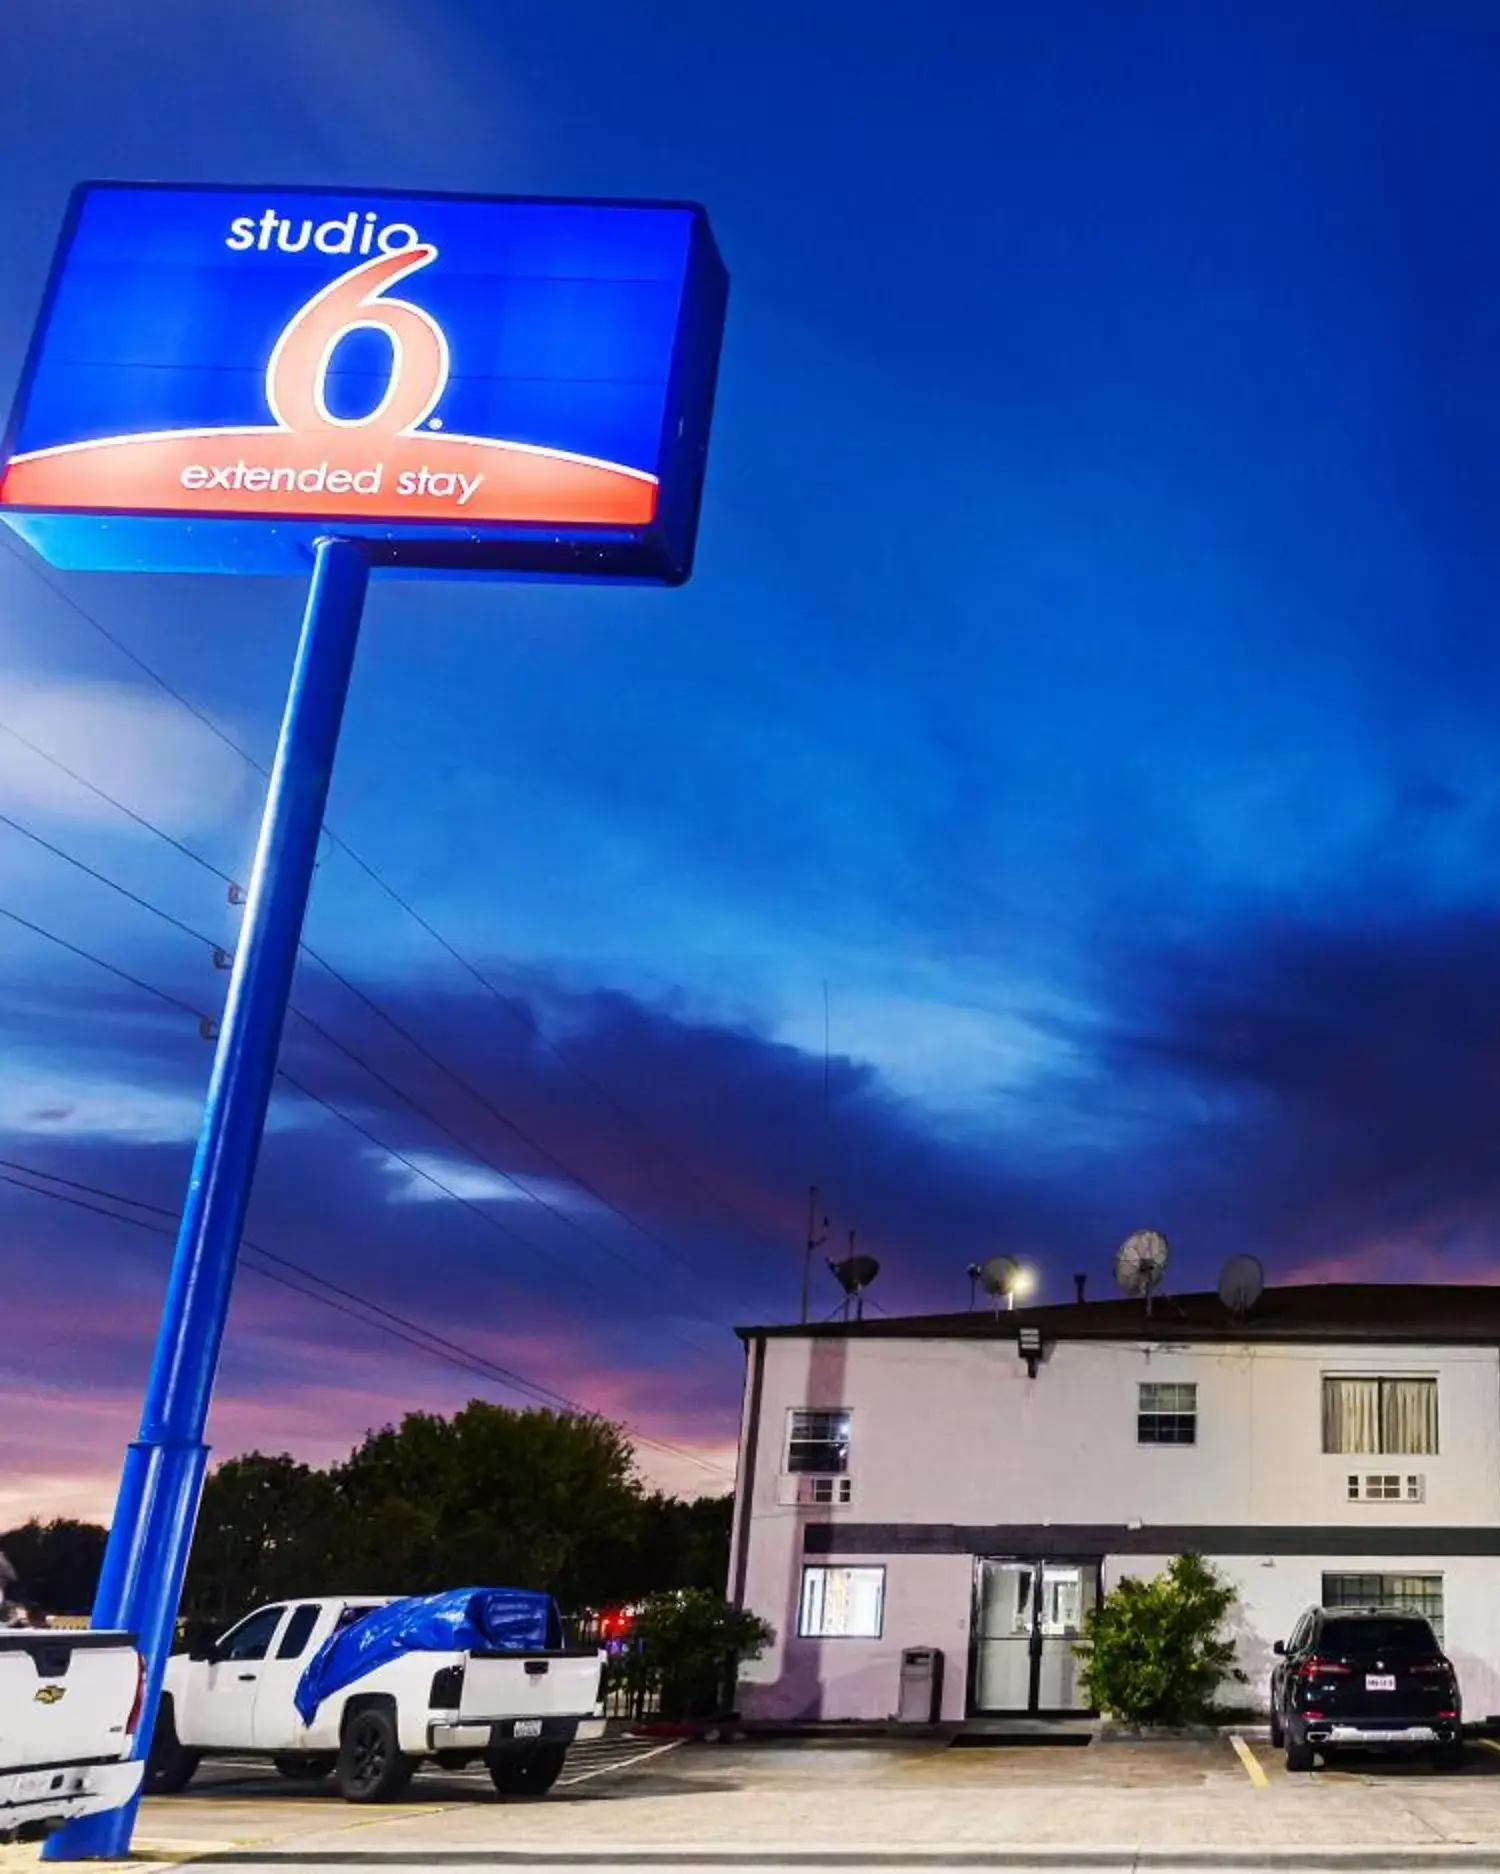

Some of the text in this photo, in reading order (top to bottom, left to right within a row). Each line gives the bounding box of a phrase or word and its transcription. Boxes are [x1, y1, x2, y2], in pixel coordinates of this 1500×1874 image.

[225, 209, 419, 254] studio
[265, 243, 449, 436] 6
[181, 460, 482, 504] extended stay
